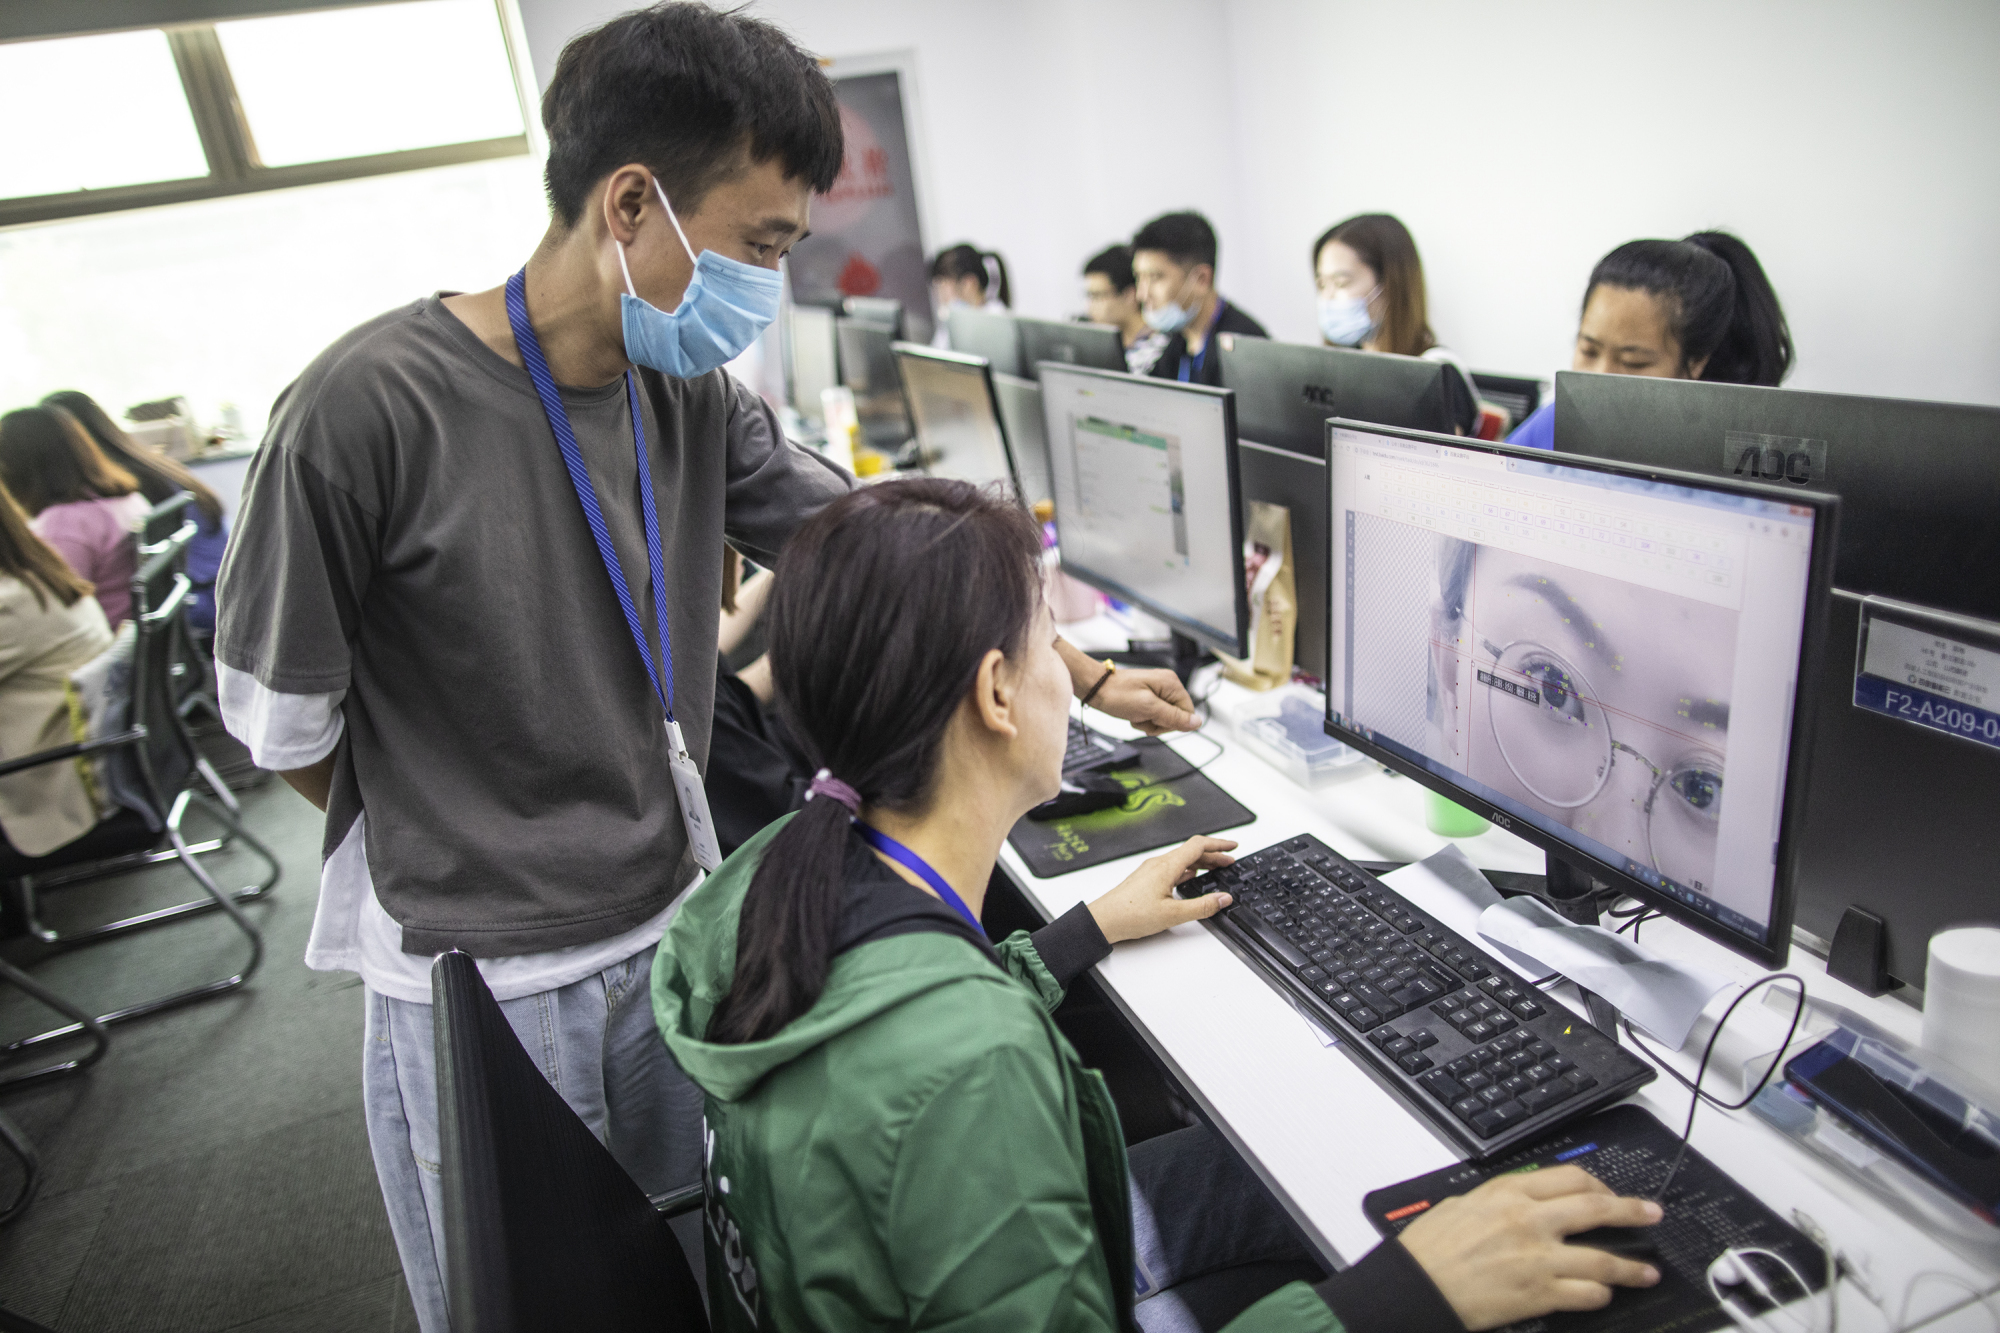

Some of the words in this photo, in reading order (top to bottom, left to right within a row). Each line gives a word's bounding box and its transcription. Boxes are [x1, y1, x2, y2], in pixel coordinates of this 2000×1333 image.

[1733, 446, 1811, 485] AOC
[1885, 690, 2000, 739] F2-A209-0
[1491, 812, 1511, 829] AOC
